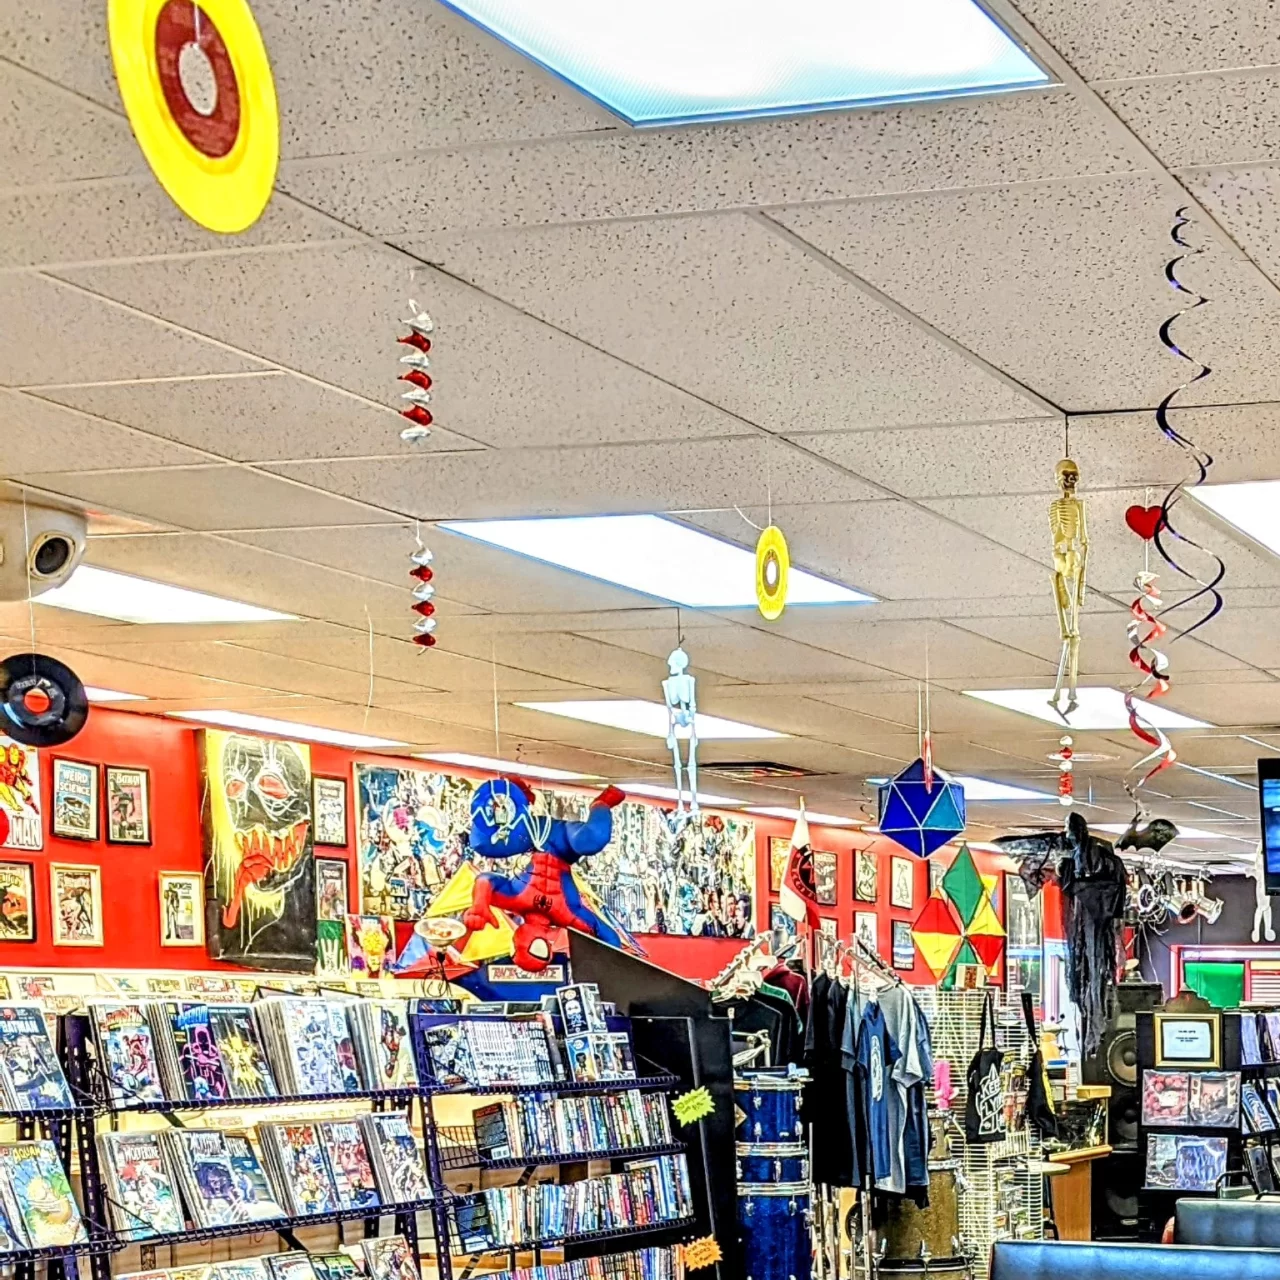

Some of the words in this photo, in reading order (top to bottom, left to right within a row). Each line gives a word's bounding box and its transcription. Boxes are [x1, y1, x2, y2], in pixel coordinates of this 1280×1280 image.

[63, 770, 87, 782] WEIRD
[60, 782, 90, 795] SCIENCE
[3, 1019, 39, 1033] BATMAN
